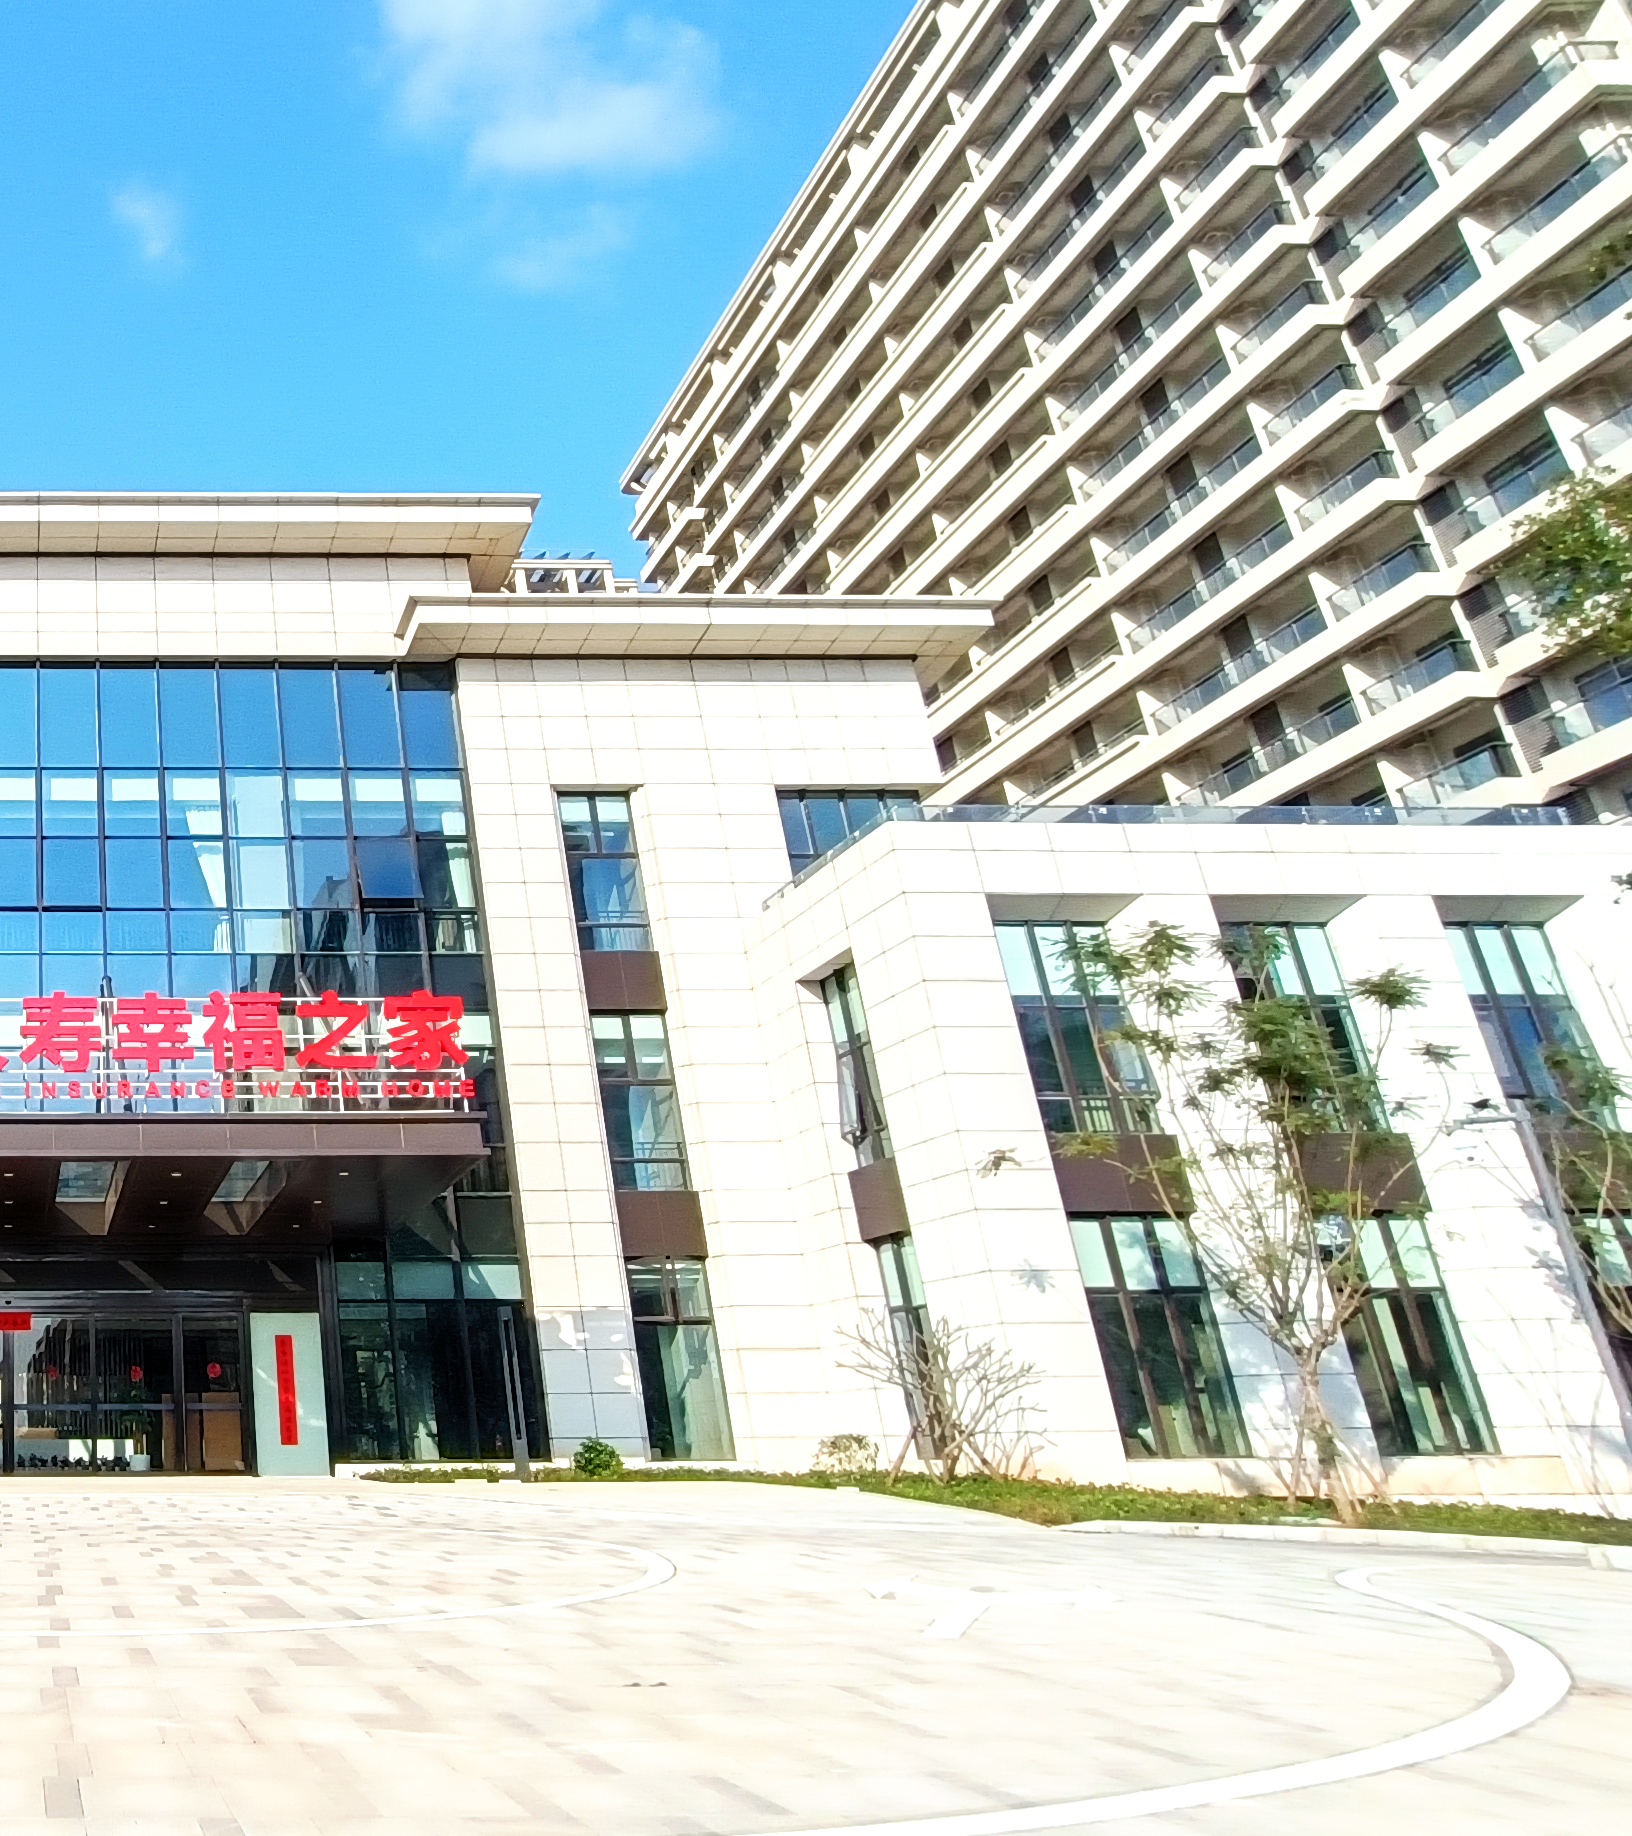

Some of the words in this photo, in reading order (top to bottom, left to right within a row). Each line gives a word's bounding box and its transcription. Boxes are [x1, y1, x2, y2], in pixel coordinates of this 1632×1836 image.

[24, 1079, 236, 1099] INSURANCE
[258, 1079, 361, 1098] WARM
[381, 1079, 477, 1098] HOME
